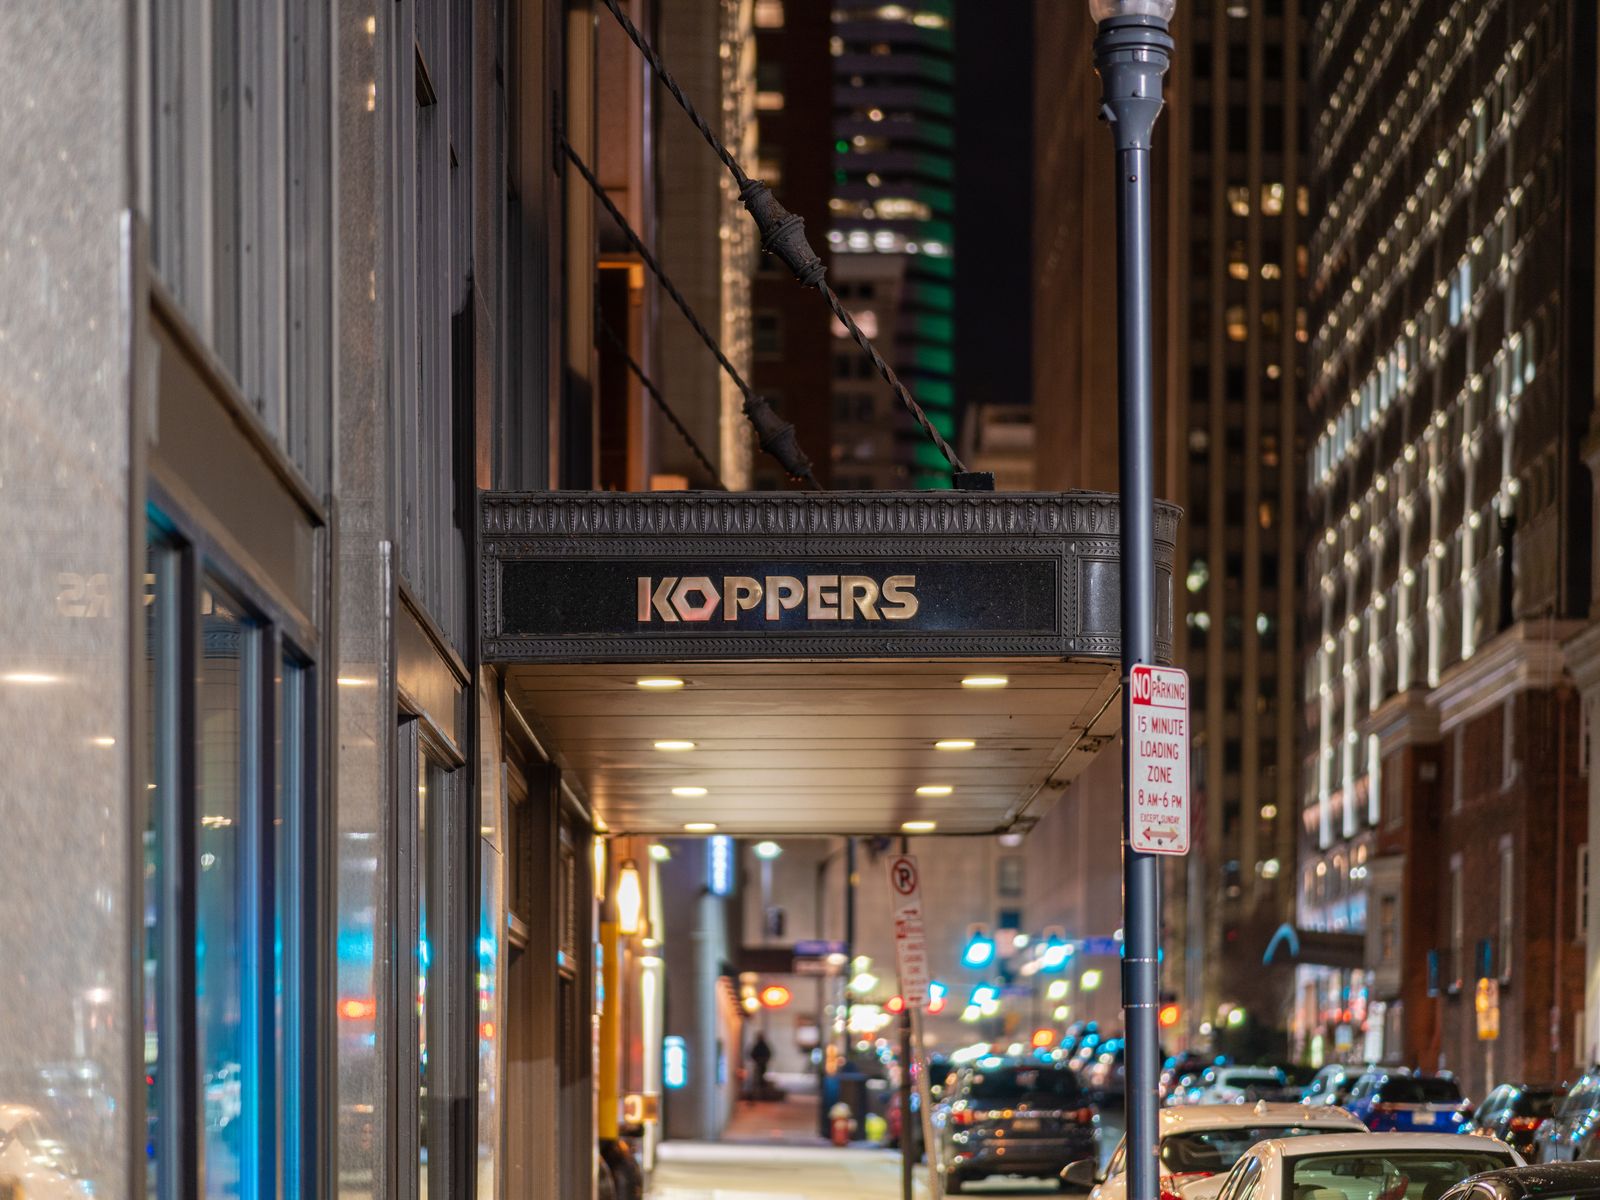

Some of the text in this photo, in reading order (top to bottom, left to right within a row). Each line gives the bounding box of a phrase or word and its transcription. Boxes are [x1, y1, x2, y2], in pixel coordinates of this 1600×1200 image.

[637, 574, 919, 622] KOPPERS
[1133, 672, 1185, 701] NO PARKING
[1137, 715, 1184, 737] 15 MINUTE
[1140, 740, 1179, 760] LOADING
[1147, 765, 1173, 783] ZONE
[1138, 789, 1144, 806] 8
[1171, 794, 1182, 808] PM
[1140, 812, 1180, 824] EXCEPT SUNDAY
